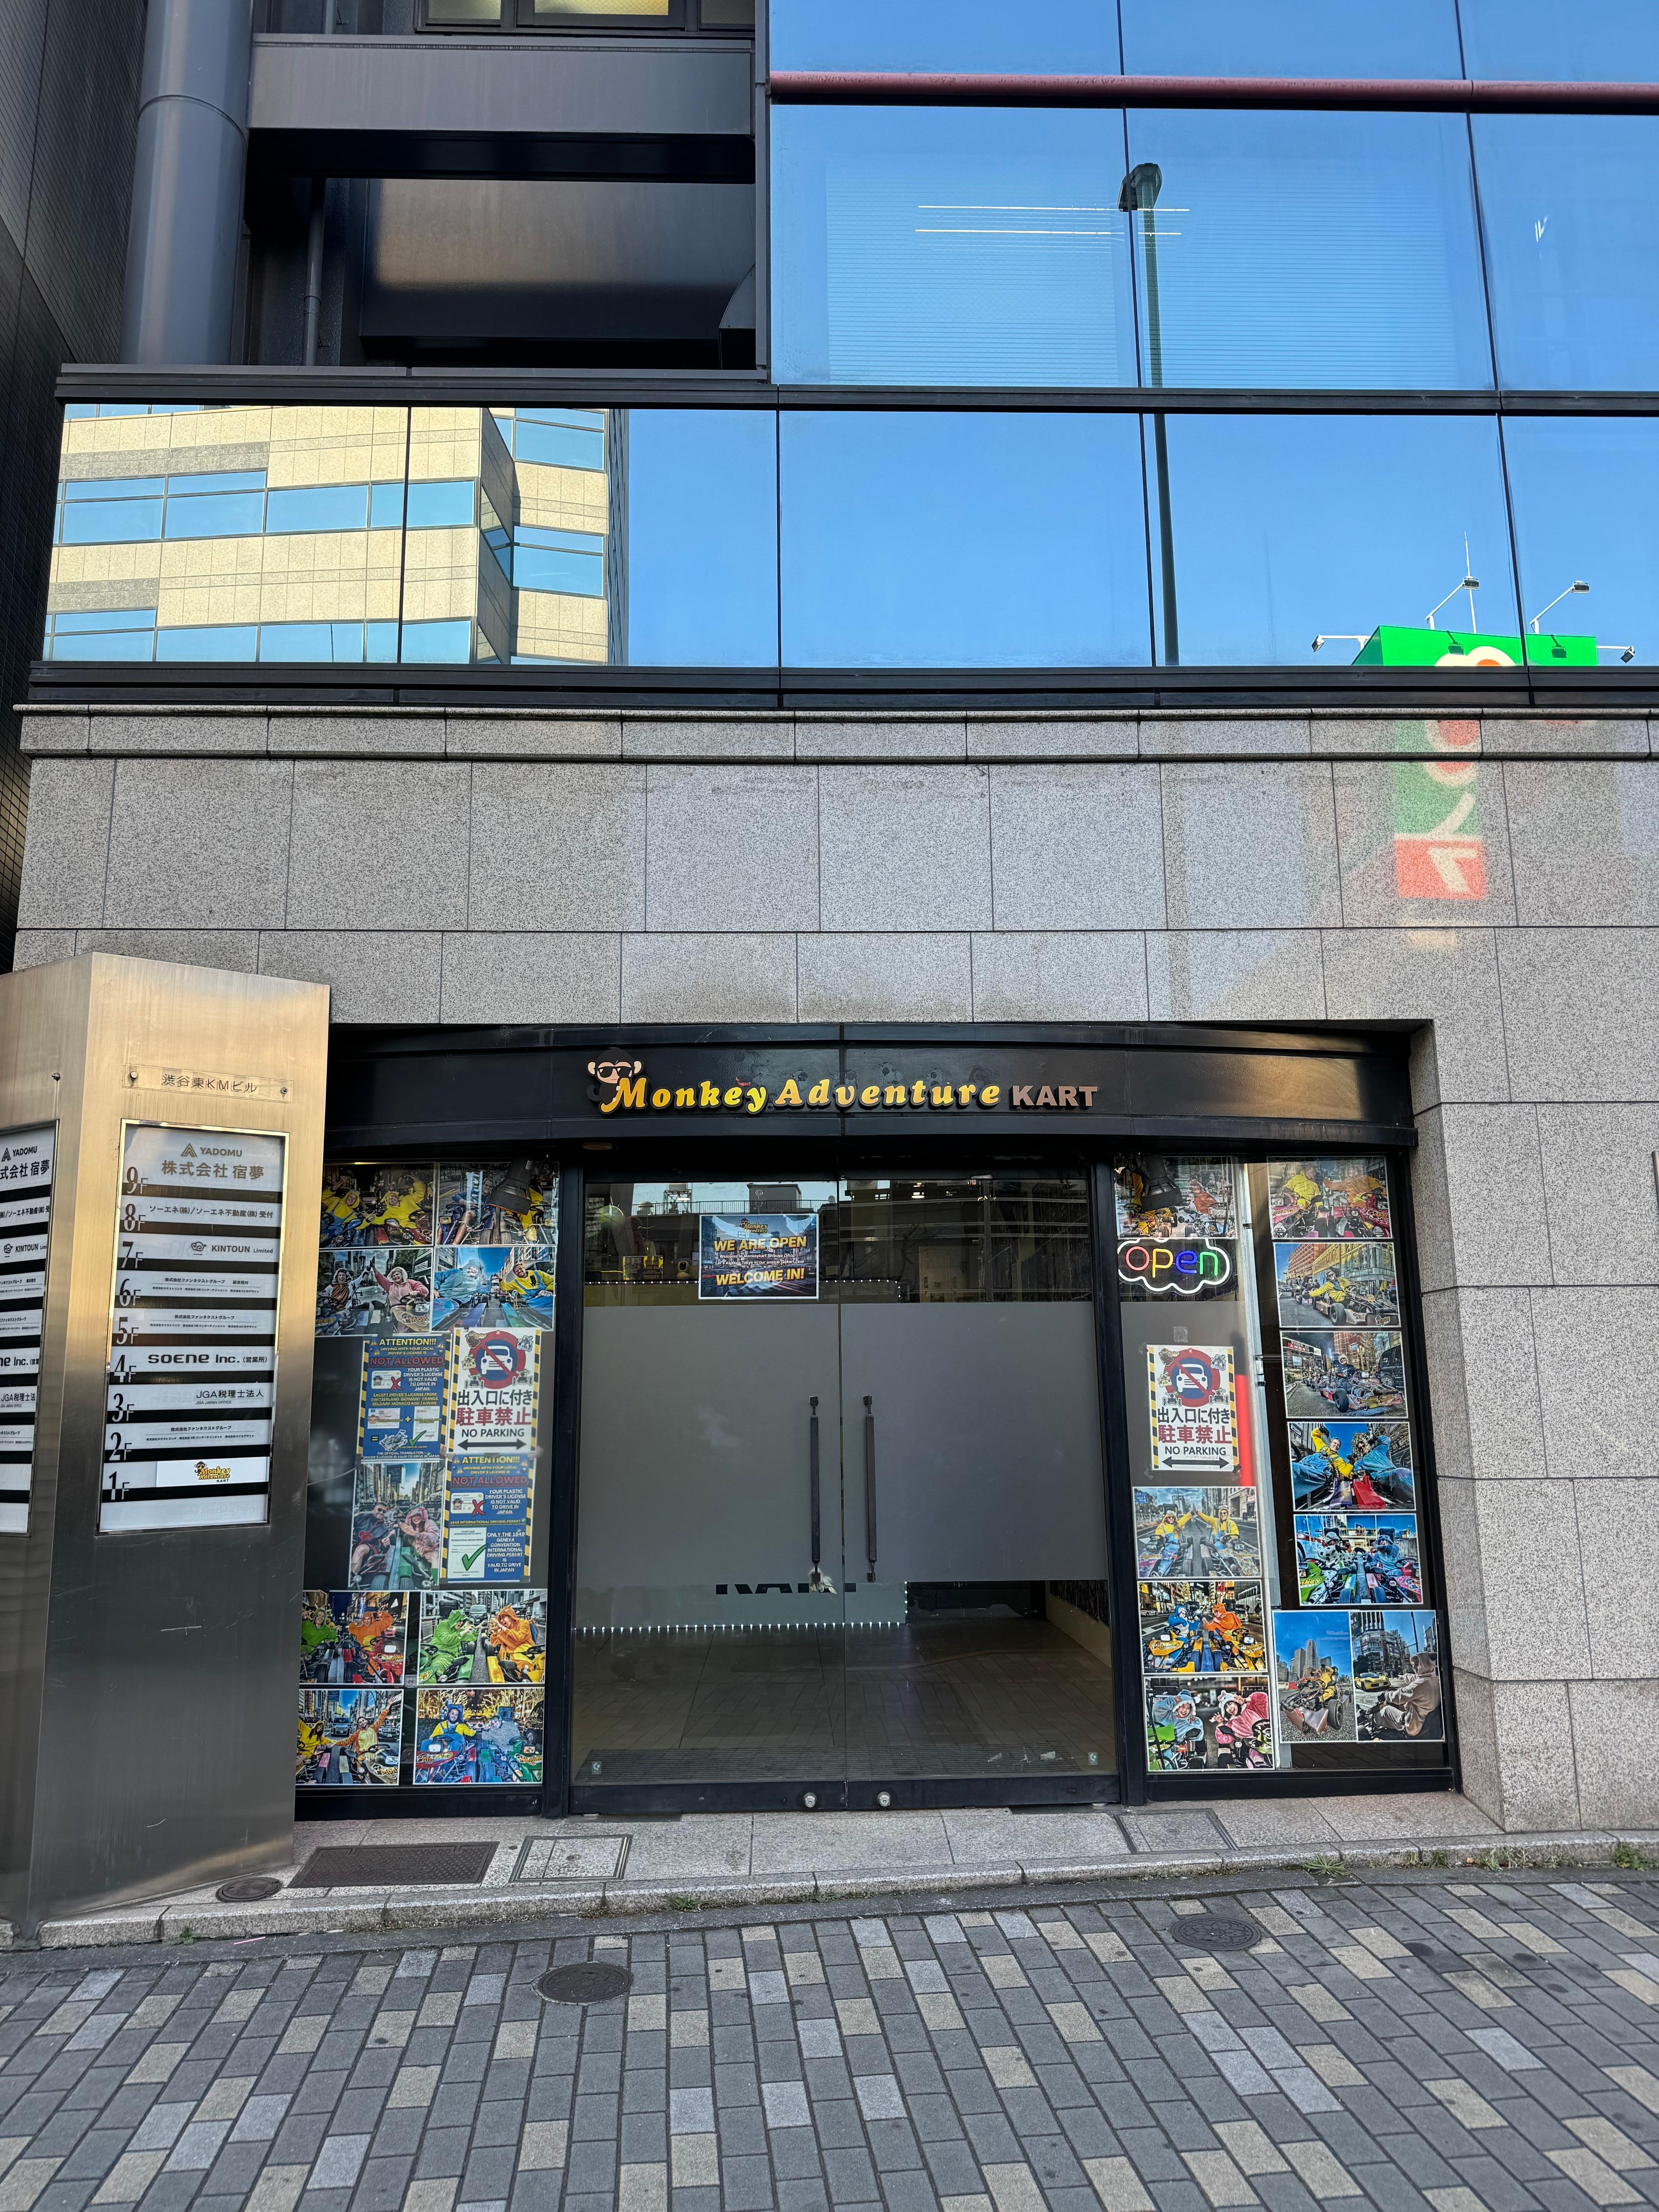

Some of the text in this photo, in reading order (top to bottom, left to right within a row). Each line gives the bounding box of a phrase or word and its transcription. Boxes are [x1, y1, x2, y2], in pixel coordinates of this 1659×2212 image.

[162, 1074, 257, 1093] 渋谷東KMビル
[601, 1077, 1097, 1113] Monkey Adventure KART
[13, 1146, 38, 1156] YADOMU
[200, 1147, 242, 1157] YADOMU
[31, 1160, 50, 1176] 宿夢
[127, 1160, 264, 1194] 9F 株式会社 宿夢
[124, 1203, 146, 1231] 8F
[15, 1243, 38, 1253] KINTOUN
[714, 1236, 807, 1252] WE ARE OPEN
[121, 1241, 144, 1269] 7F
[211, 1245, 251, 1253] KINTOUN
[716, 1268, 805, 1286] WELCOME IN!
[119, 1278, 141, 1306] 6F
[116, 1317, 139, 1344] 5F
[14, 1357, 28, 1366] Inc.
[114, 1355, 137, 1382] 4F
[215, 1354, 240, 1363] Inc.
[370, 1356, 444, 1365] NOT ALLOWED
[112, 1389, 264, 1422] 3F JGA税理士法人
[457, 1389, 532, 1406] 出入口に付き
[456, 1407, 531, 1426] 駐車禁止
[1158, 1407, 1230, 1424] 出入口に付き
[462, 1429, 525, 1437] NO PARKING
[1158, 1424, 1232, 1444] 駐車禁止
[109, 1432, 132, 1460] 2F
[1165, 1446, 1226, 1456] NO PARKING
[197, 1466, 231, 1476] Monkey
[108, 1471, 130, 1500] 1F
[452, 1476, 527, 1485] NOT ALLOWED
